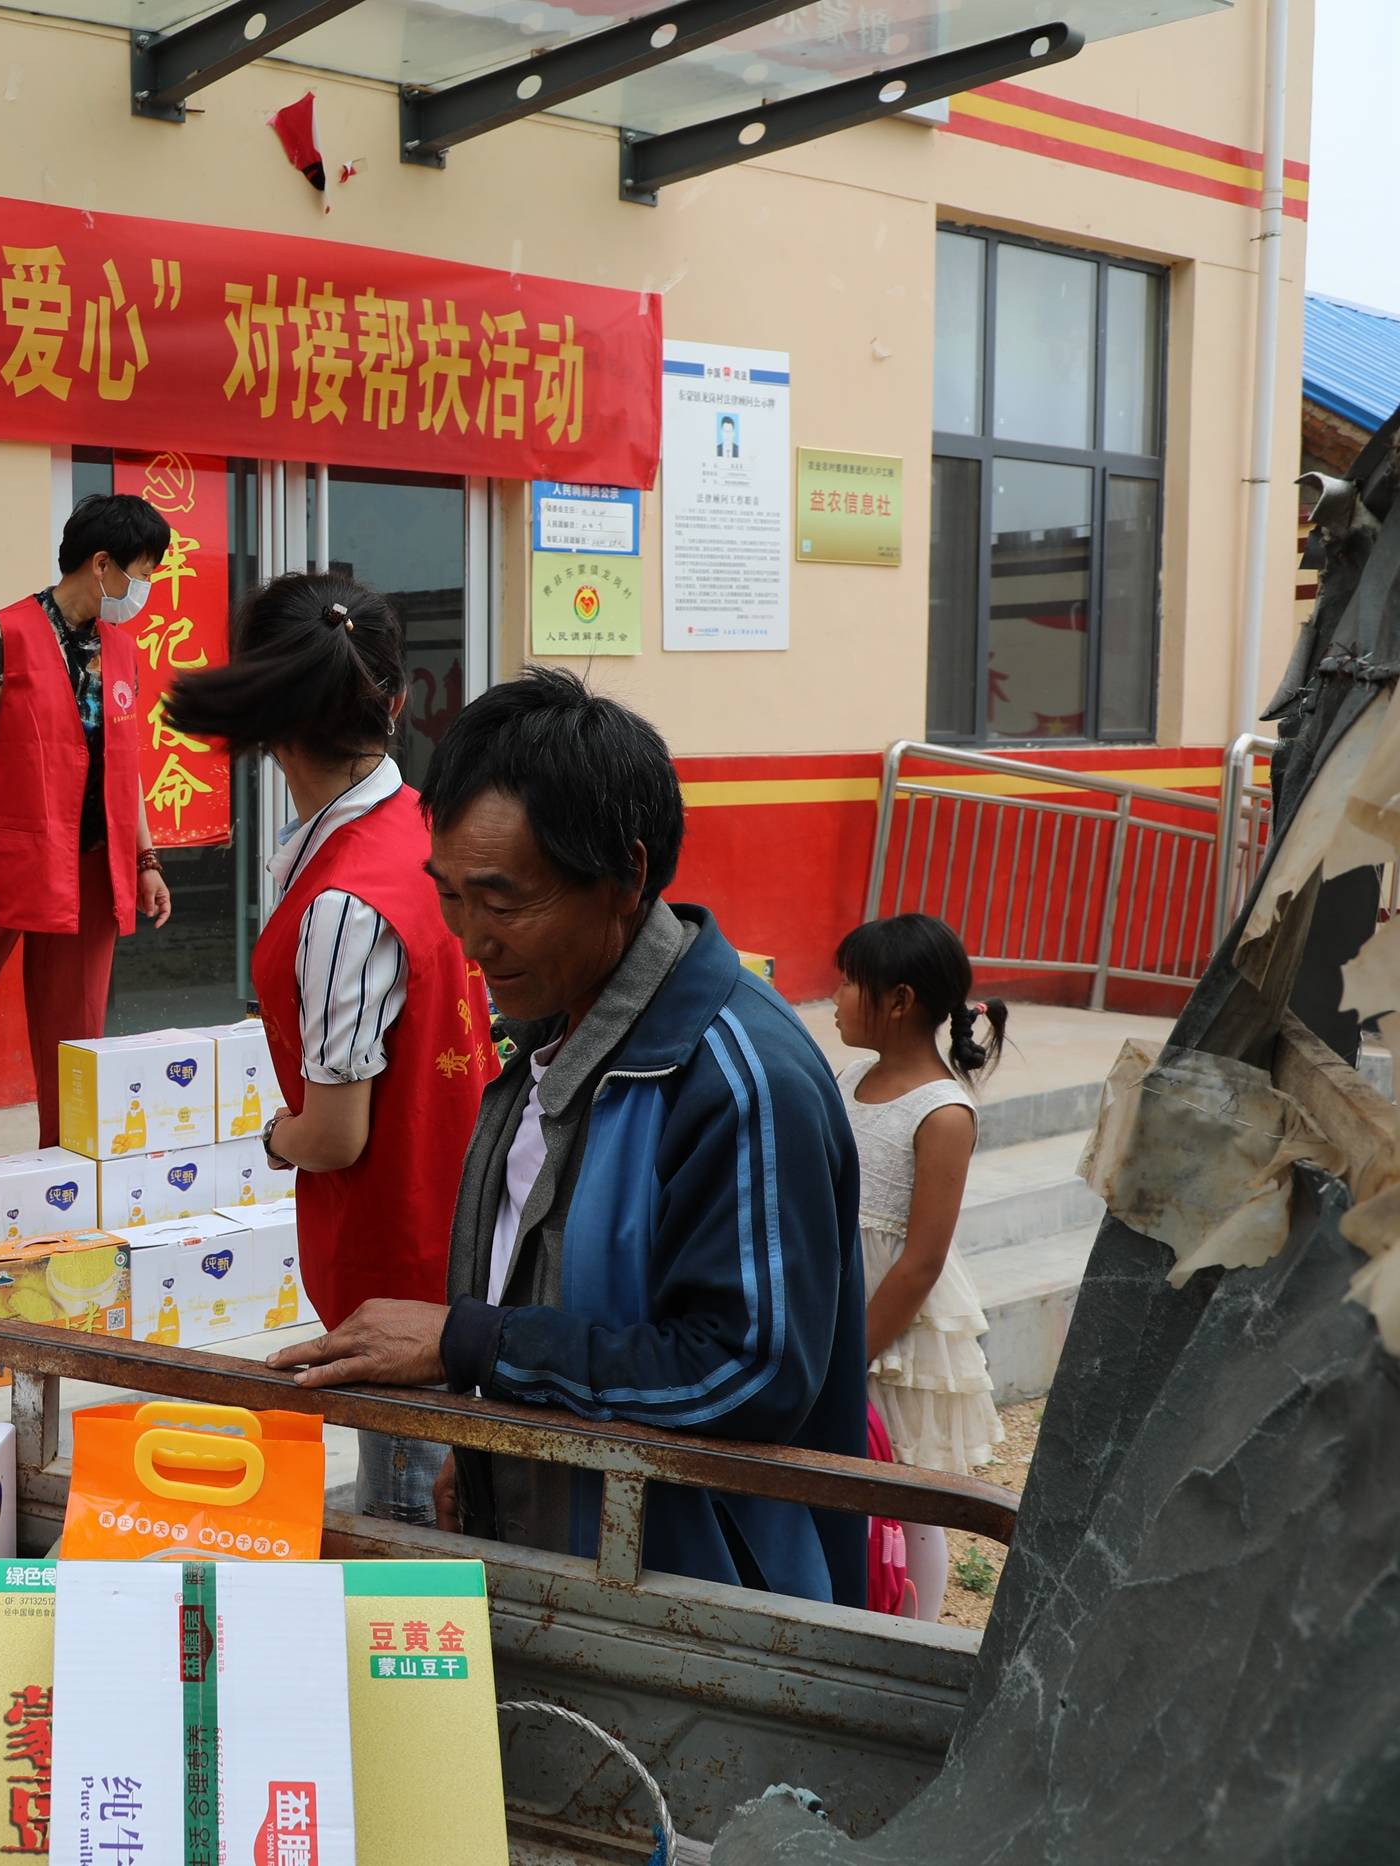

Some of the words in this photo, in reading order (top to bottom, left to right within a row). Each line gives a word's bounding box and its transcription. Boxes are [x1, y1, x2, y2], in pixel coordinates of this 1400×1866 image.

[810, 489, 891, 517] 益农信息社
[5, 1566, 57, 1586] 绿色食
[368, 1619, 467, 1654] 豆黄金
[376, 1657, 461, 1678] 蒙山豆干
[186, 1724, 210, 1820] 合理营养
[80, 1775, 94, 1821] Pure
[266, 1833, 275, 1858] SHAN
